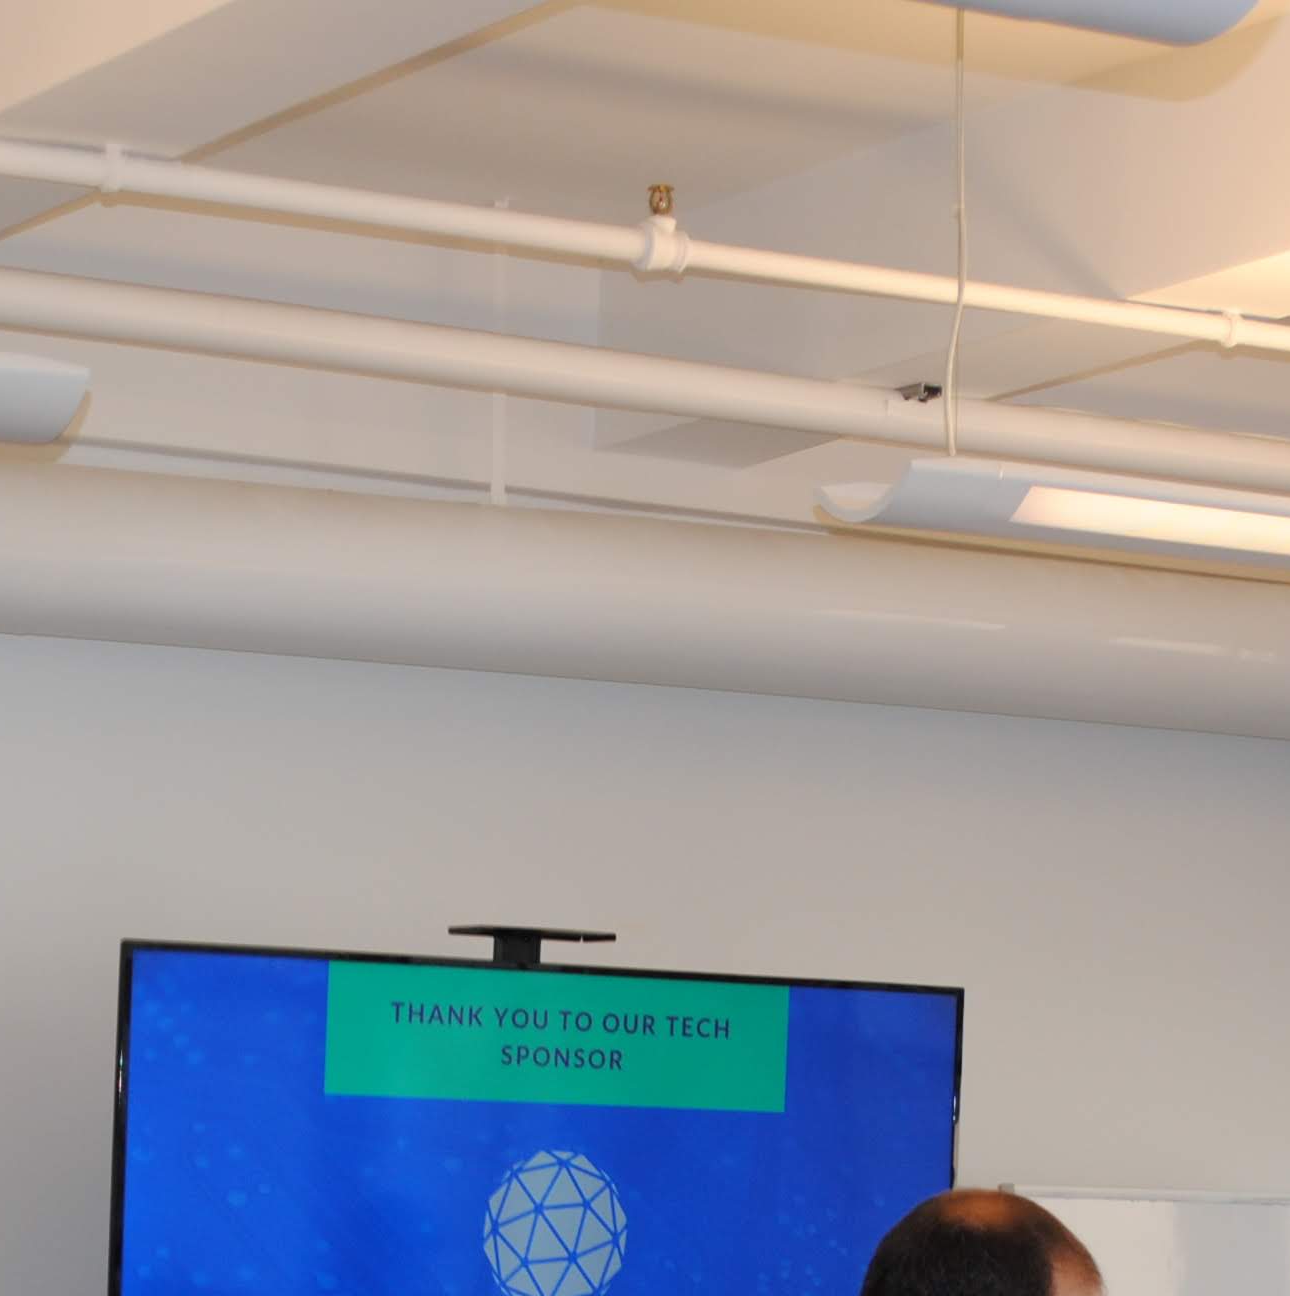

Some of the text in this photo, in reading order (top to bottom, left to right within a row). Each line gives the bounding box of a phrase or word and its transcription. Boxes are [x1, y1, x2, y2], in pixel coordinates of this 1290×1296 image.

[391, 1001, 730, 1040] THANK YOU TO OUR TECH
[500, 1045, 623, 1070] SPONSOR
